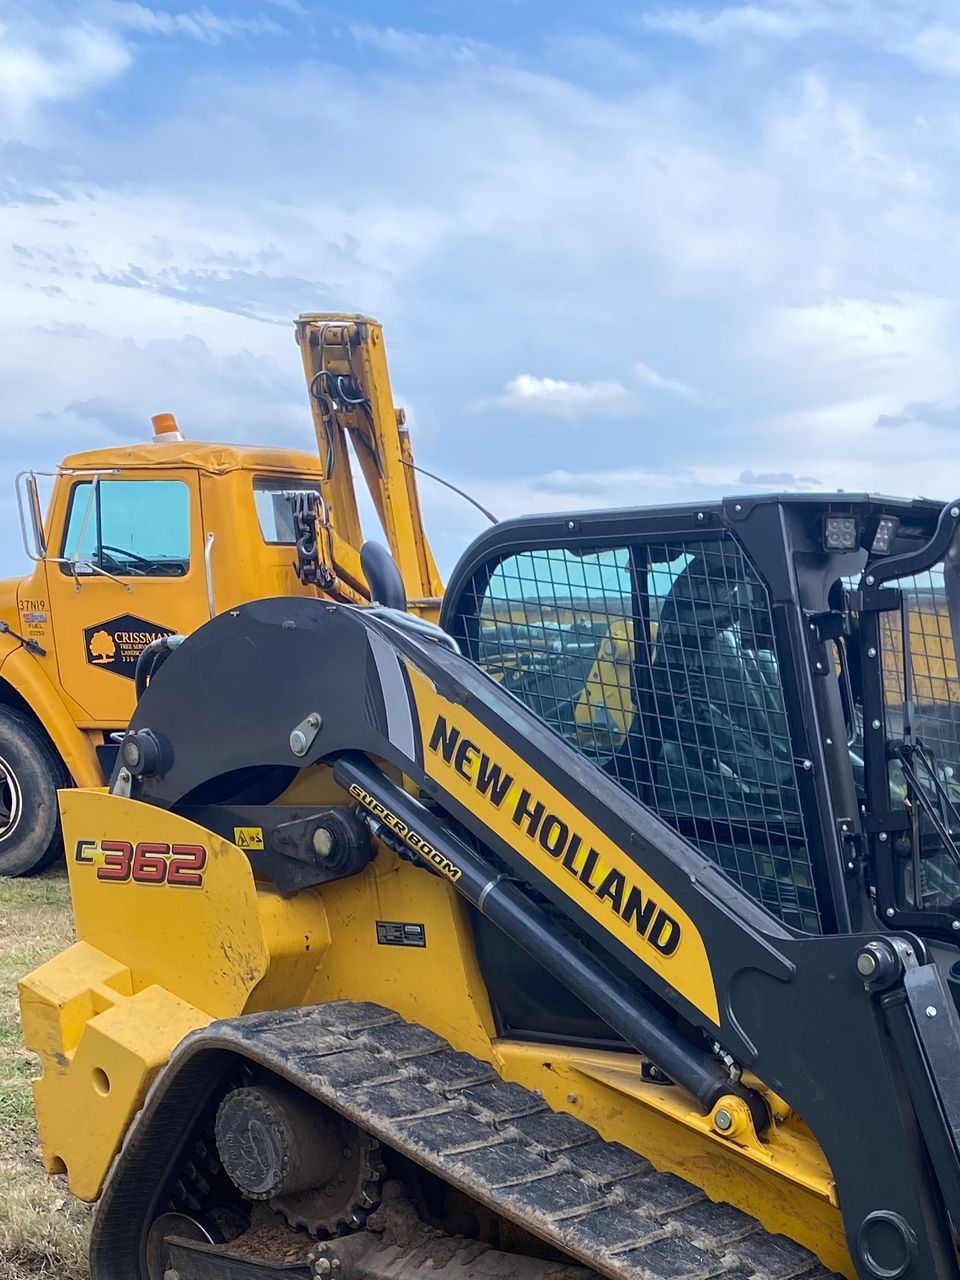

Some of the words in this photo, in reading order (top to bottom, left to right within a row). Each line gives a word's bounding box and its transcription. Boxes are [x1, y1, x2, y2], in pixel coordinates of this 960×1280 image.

[76, 839, 206, 886] C362
[350, 784, 407, 835] SUPER
[408, 832, 460, 878] BOOM
[429, 715, 514, 807] NEW
[512, 788, 681, 956] HOLLAND
